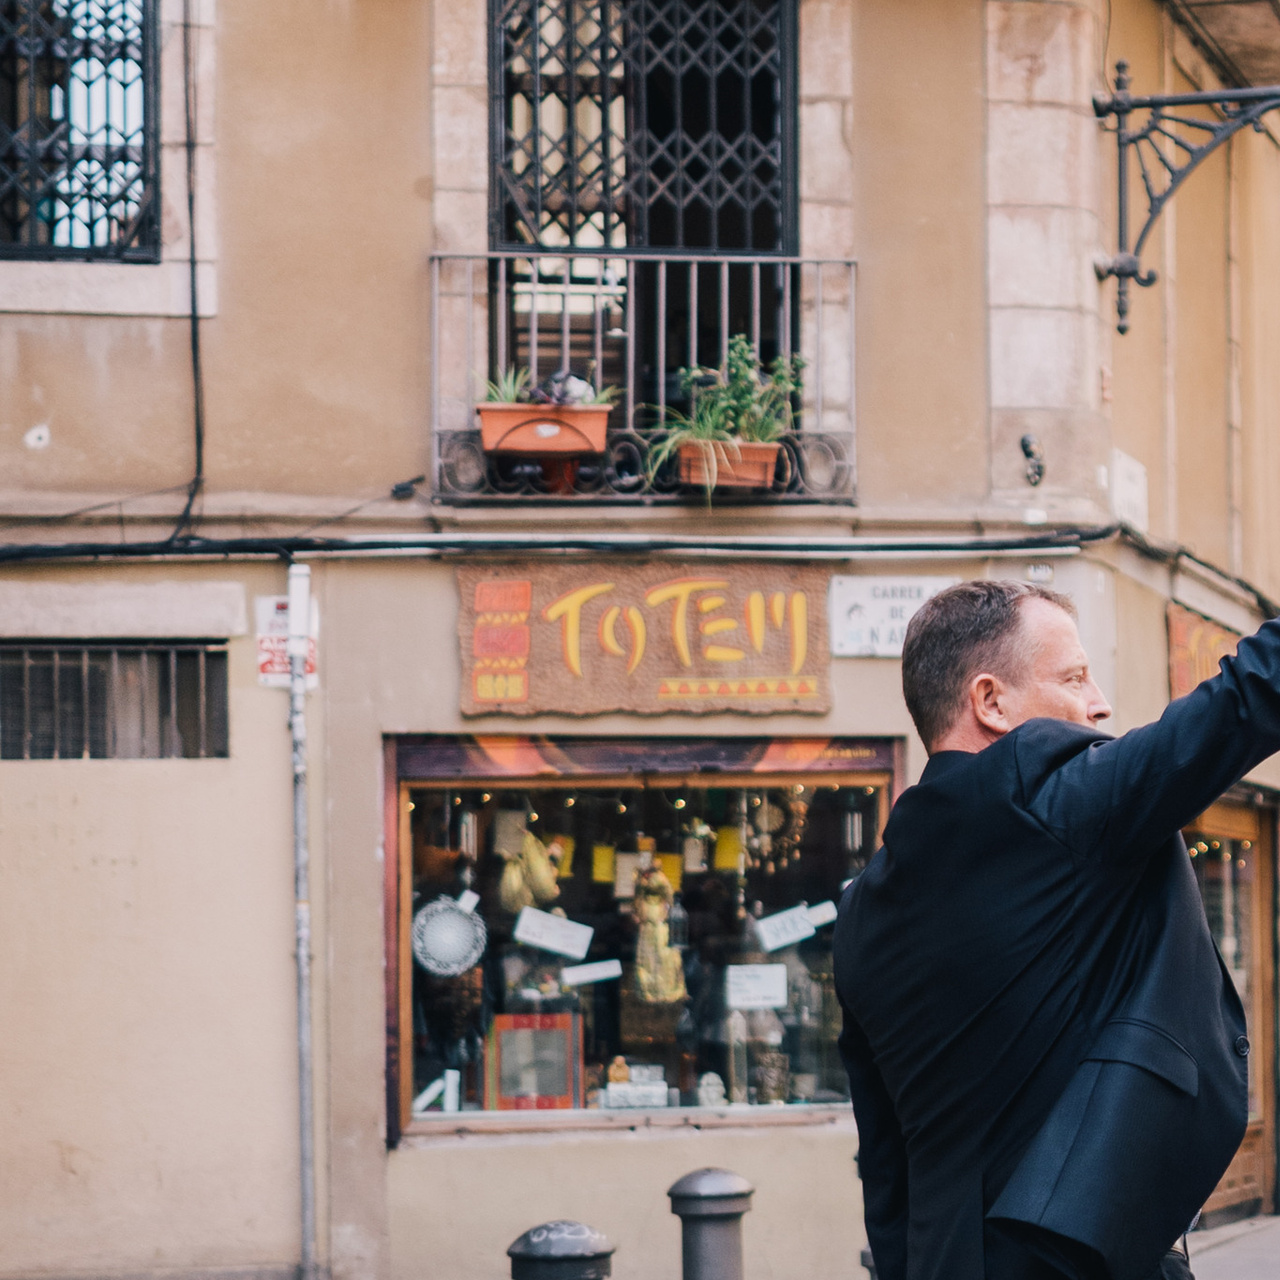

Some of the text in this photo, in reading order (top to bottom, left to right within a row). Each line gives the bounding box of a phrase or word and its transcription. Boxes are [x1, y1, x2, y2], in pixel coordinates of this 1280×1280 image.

[871, 586, 924, 600] CARRER
[890, 606, 905, 620] DE
[544, 578, 807, 676] TOTEM
